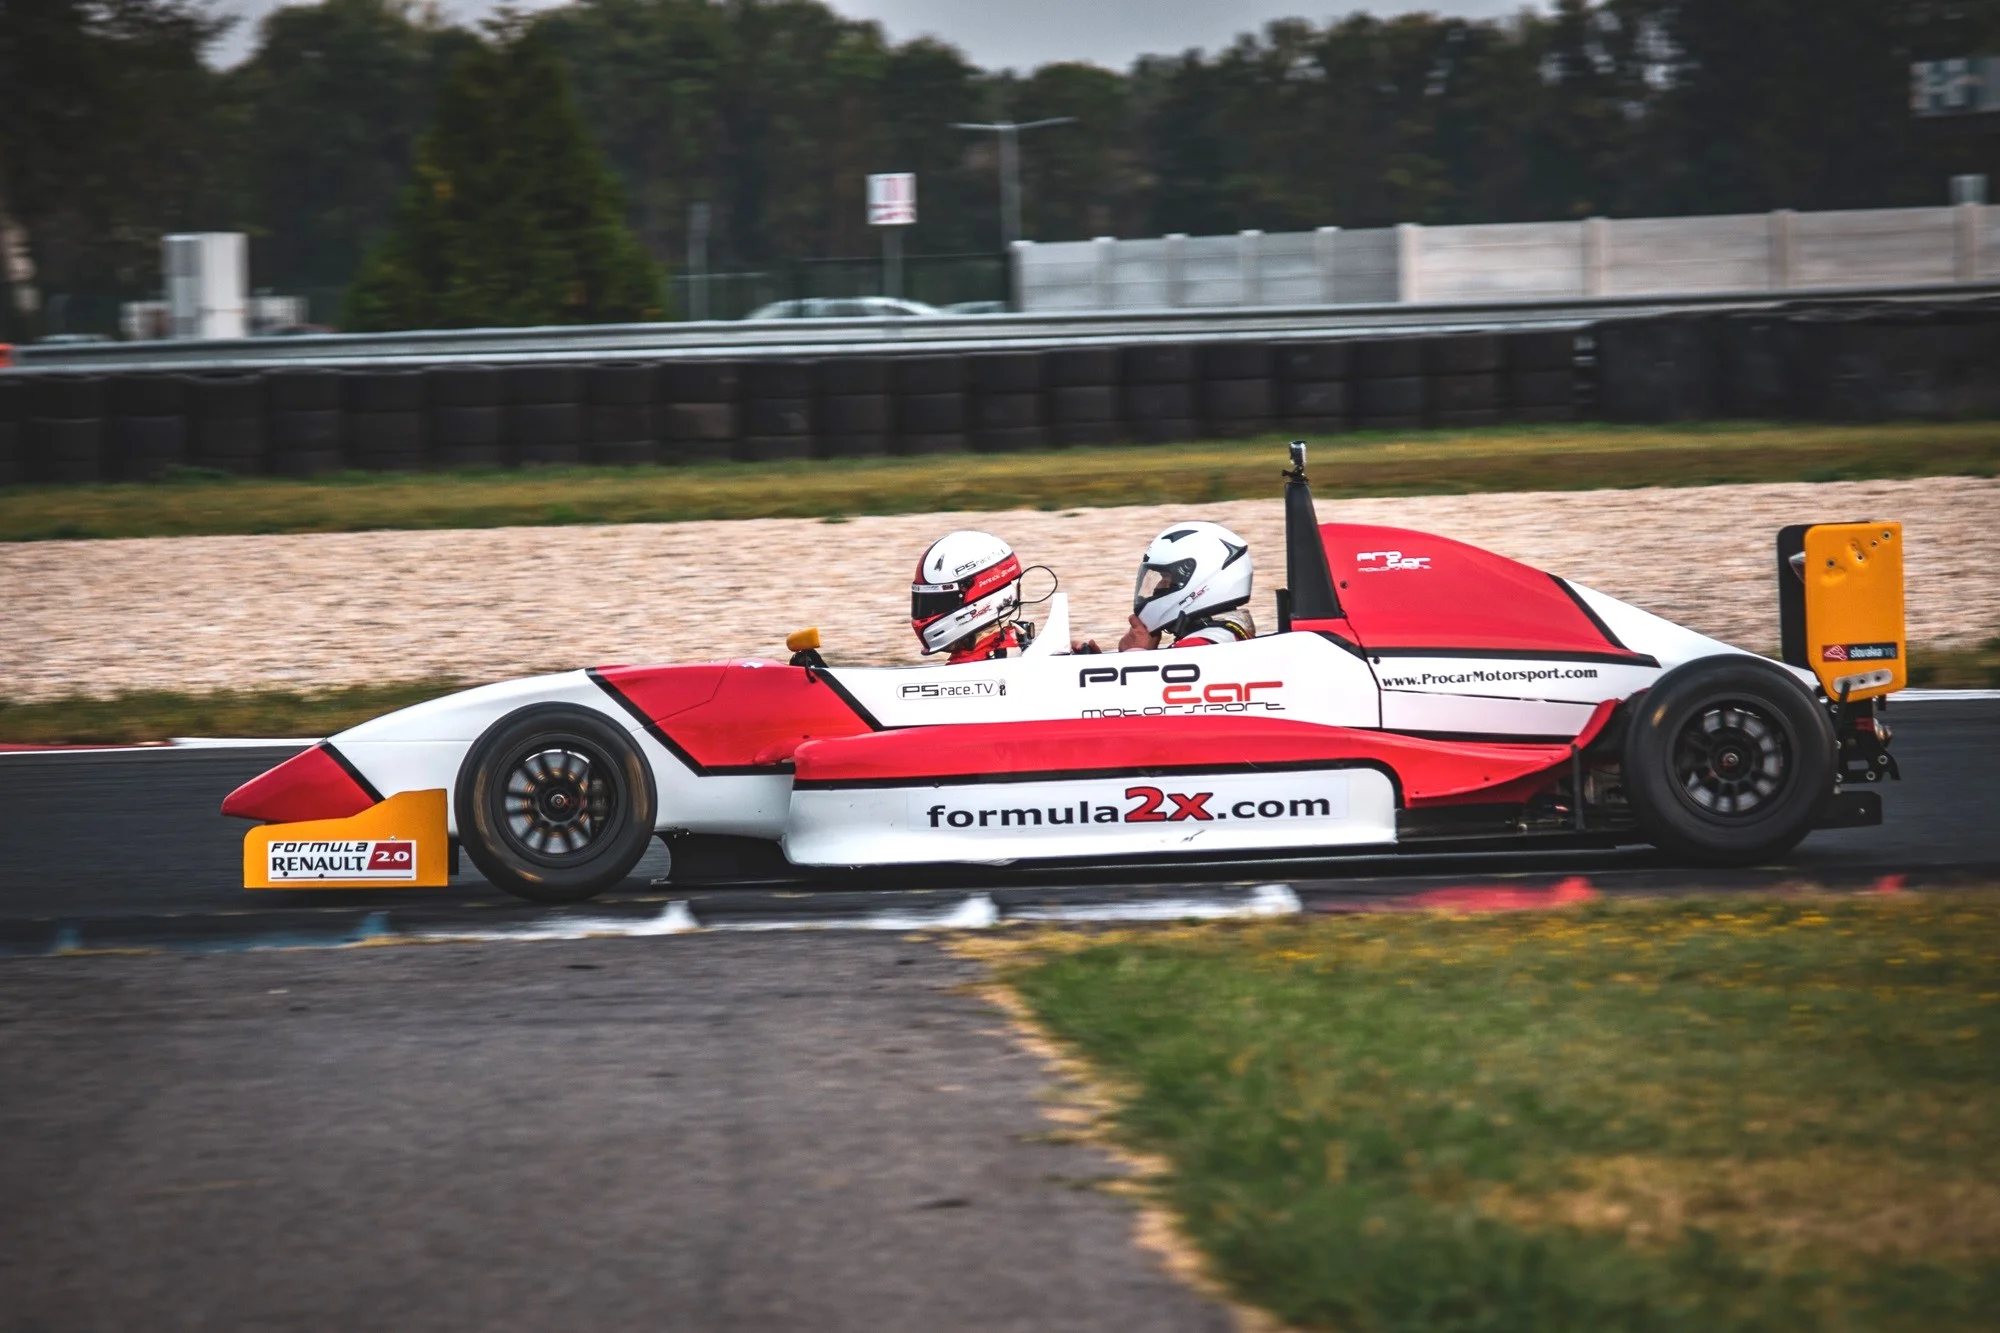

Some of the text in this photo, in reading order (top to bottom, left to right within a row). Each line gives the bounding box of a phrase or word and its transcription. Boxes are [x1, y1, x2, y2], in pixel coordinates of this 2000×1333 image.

[1382, 667, 1598, 687] www.ProcarMotorsport.com
[927, 786, 1331, 828] formula2x.com
[272, 850, 410, 871] RENAULT 2.0
